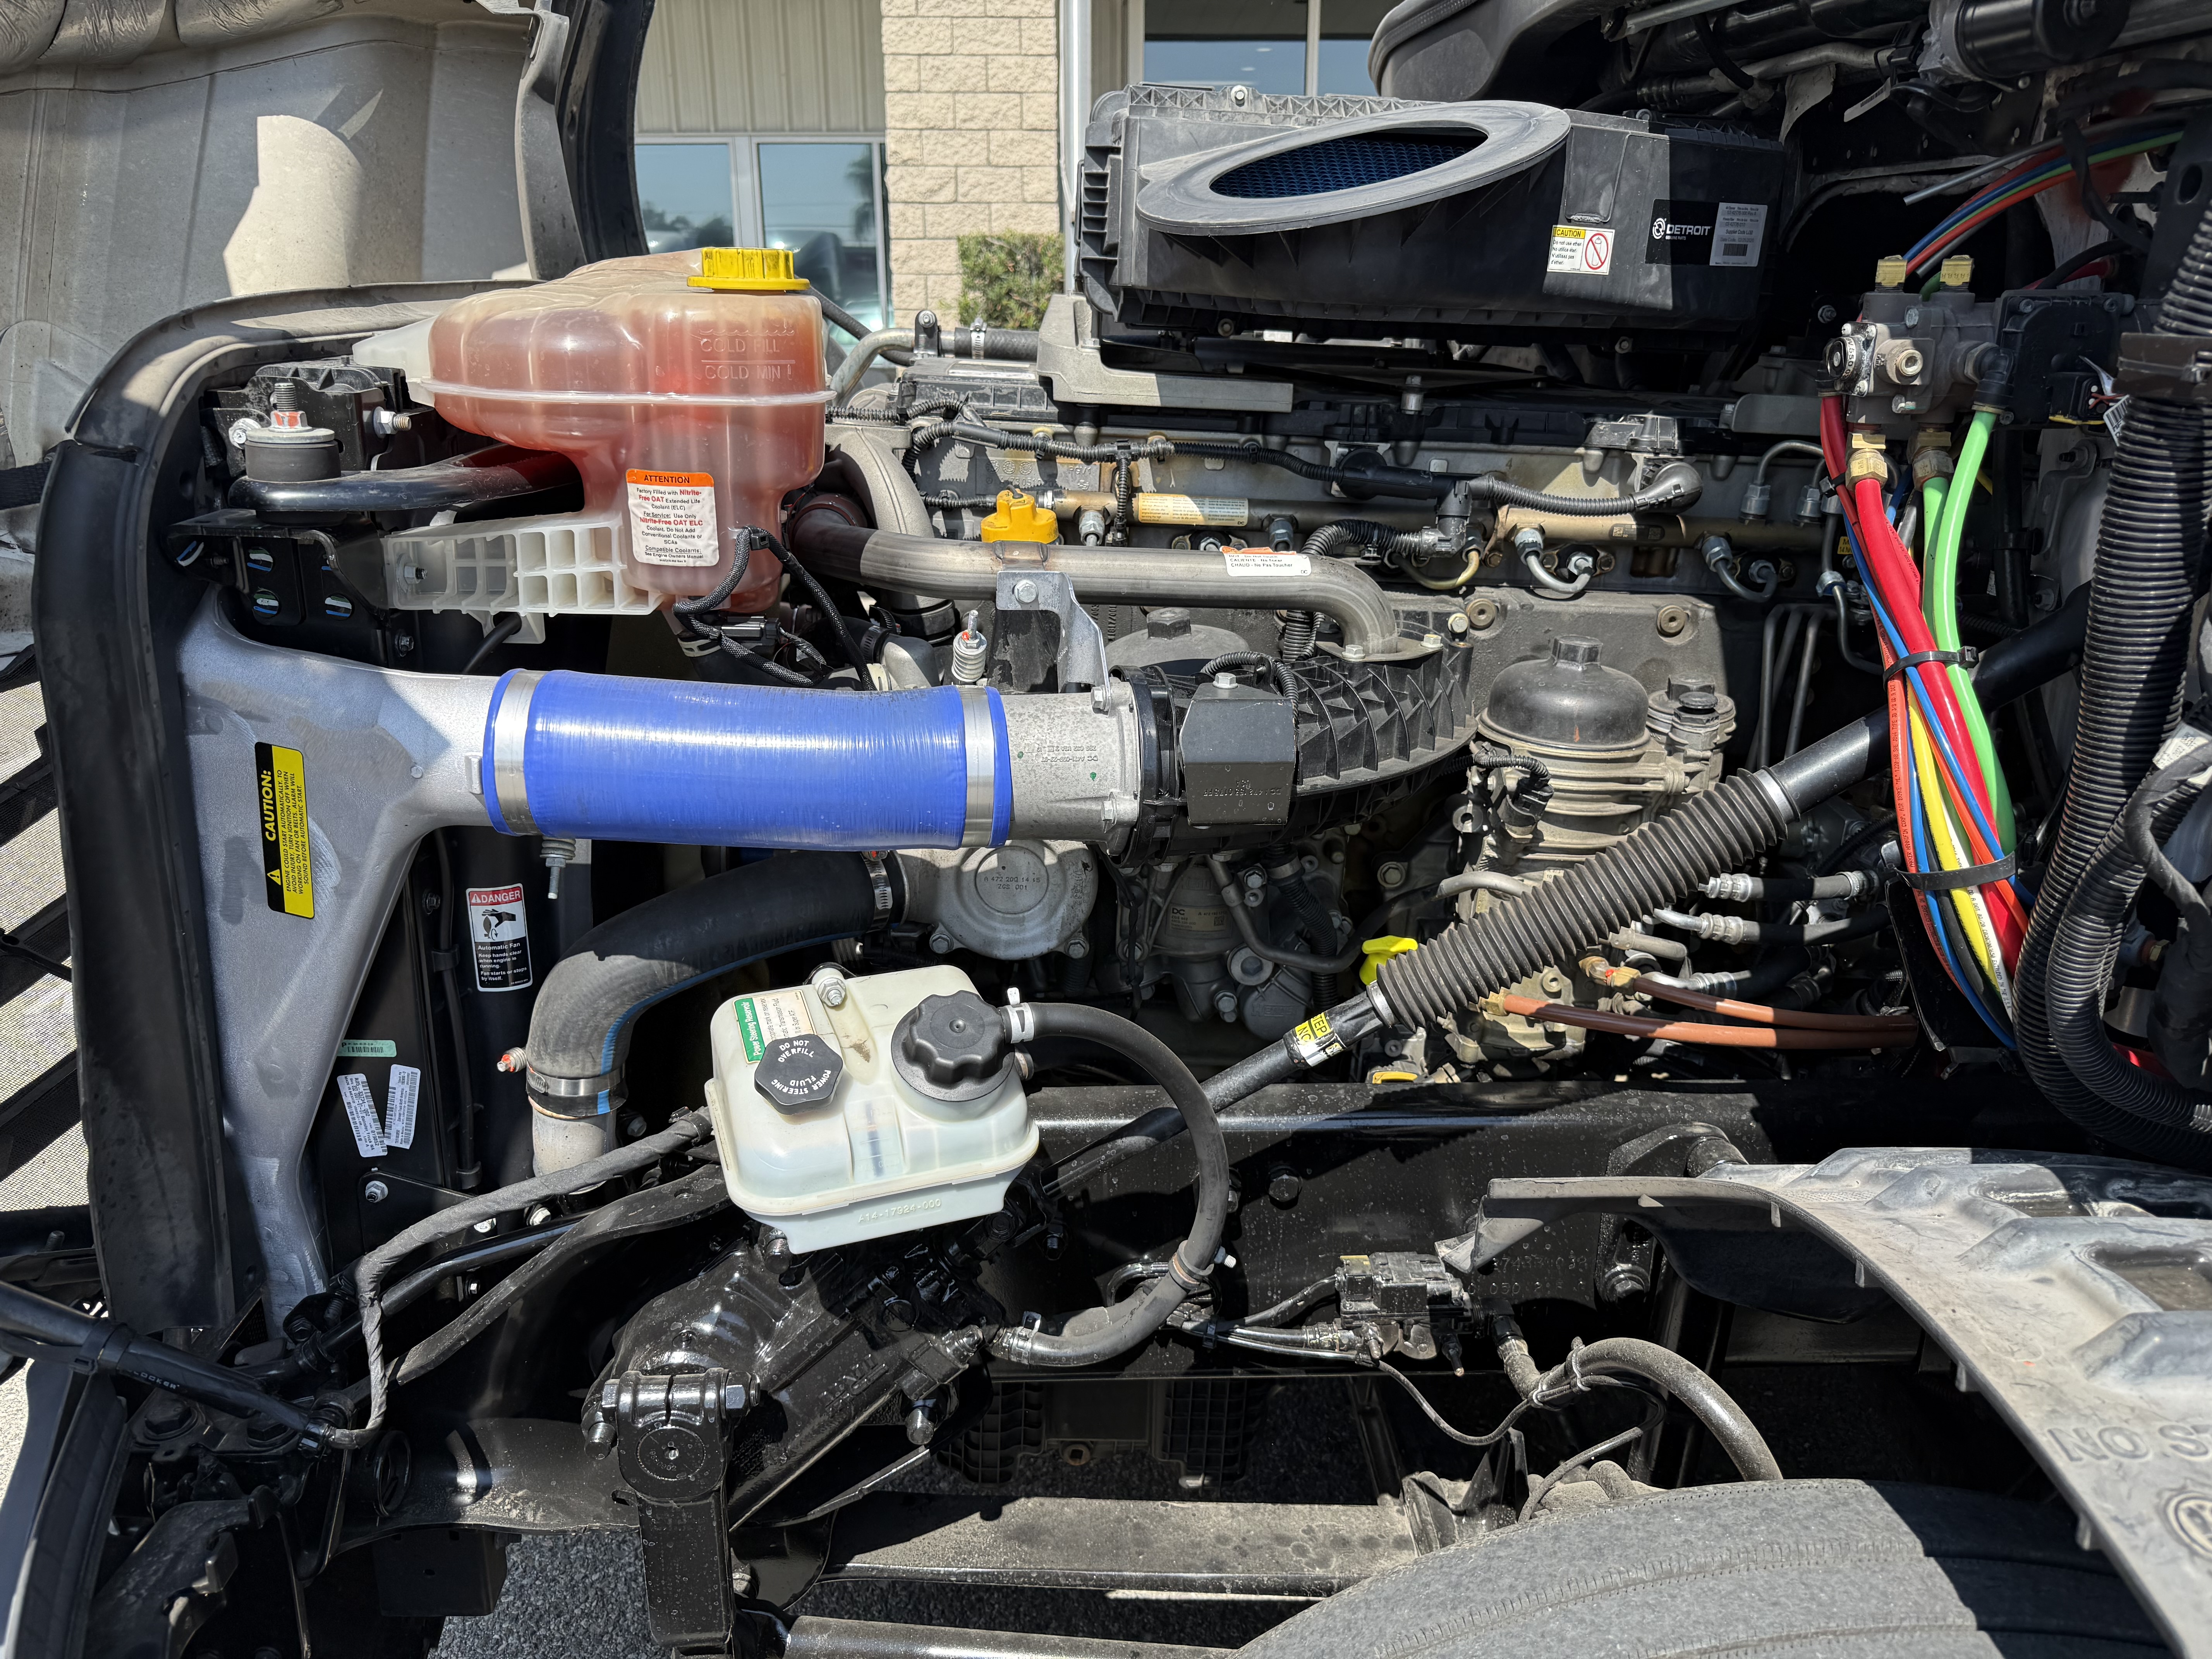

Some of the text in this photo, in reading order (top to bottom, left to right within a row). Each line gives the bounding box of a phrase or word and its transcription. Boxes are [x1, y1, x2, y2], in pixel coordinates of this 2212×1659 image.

[1557, 229, 1581, 237] CAUTION
[1666, 224, 1711, 235] DETROIT
[701, 339, 780, 353] COLD FILL
[705, 366, 780, 381] COLD MIN
[644, 475, 690, 483] ATTENTION
[639, 517, 672, 525] Nitrite-Free
[261, 770, 276, 841] CAUTION:
[278, 780, 286, 829] AUTOMATICALLY.
[294, 830, 299, 838] OR
[295, 855, 300, 863] ON
[482, 890, 520, 903] DANGER
[1992, 960, 2002, 980] EXTRUDED
[776, 1007, 786, 1027] Transmission
[792, 1016, 800, 1026] Super
[741, 1002, 762, 1056] Power Steering Reservoir
[779, 1042, 790, 1051] DO
[778, 1048, 814, 1062] OVERFILL
[771, 1070, 831, 1094] POWER STEERING
[790, 1075, 816, 1086] FLUID
[858, 1199, 941, 1223] A14-17924-000
[2047, 1426, 2152, 1462] NO
